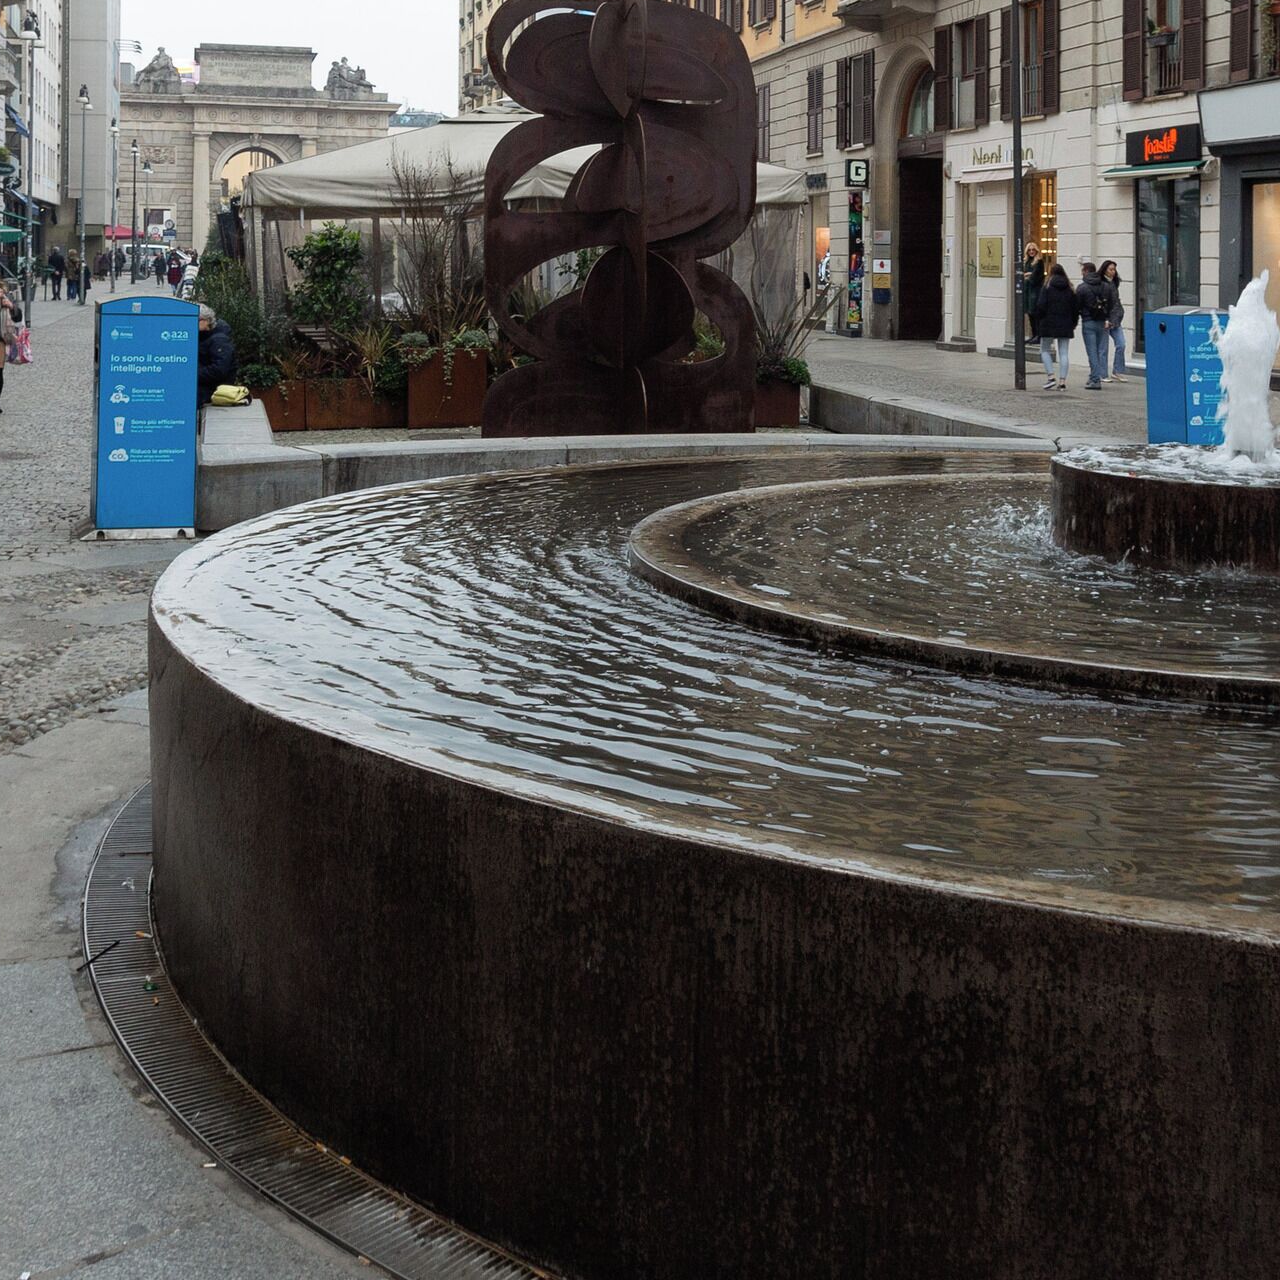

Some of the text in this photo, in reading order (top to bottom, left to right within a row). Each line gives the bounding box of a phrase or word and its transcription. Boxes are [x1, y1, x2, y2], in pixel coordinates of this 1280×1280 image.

[850, 161, 867, 182] G
[171, 330, 189, 339] a2a
[147, 353, 153, 362] il
[154, 354, 188, 363] cestino
[110, 364, 162, 374] intelligente
